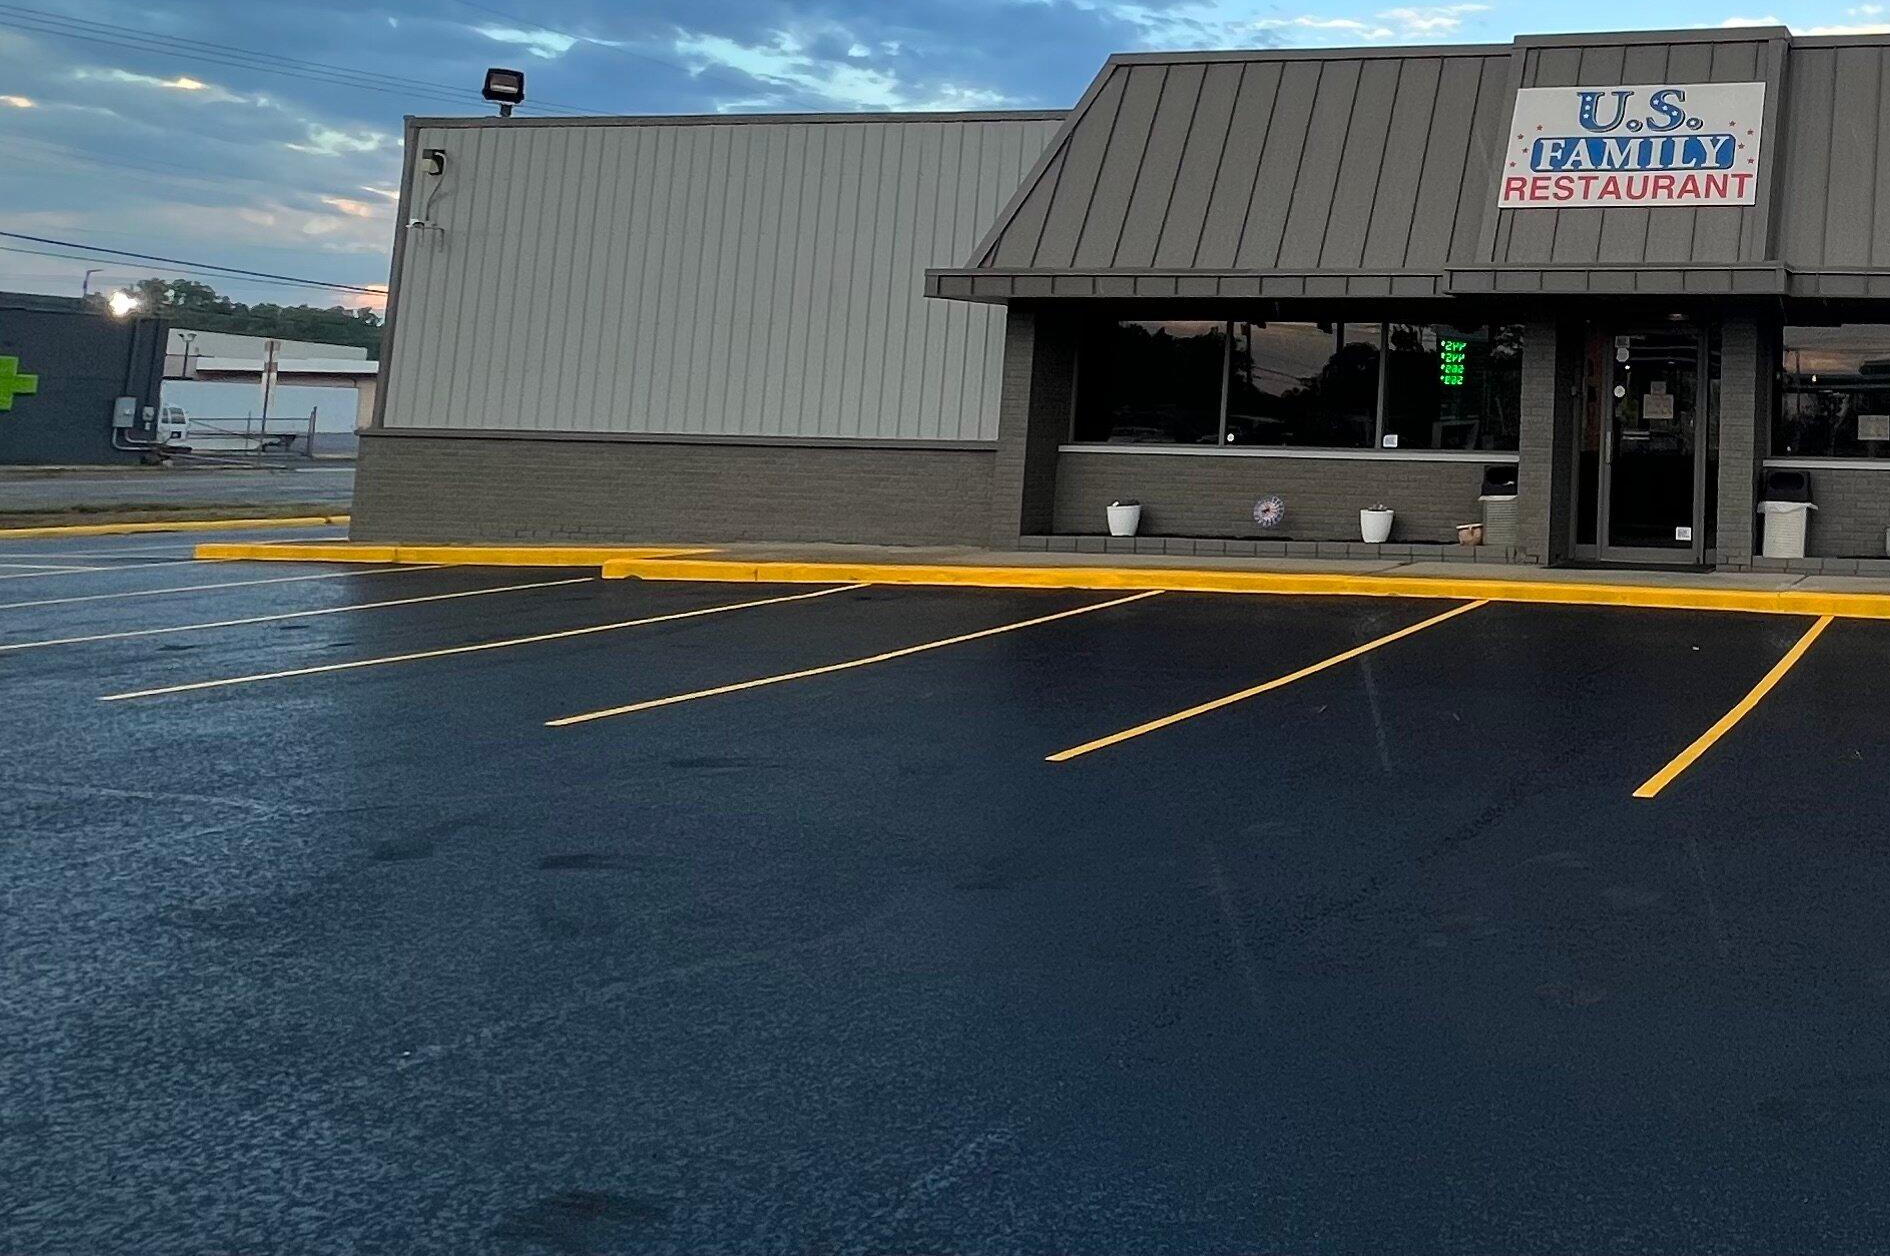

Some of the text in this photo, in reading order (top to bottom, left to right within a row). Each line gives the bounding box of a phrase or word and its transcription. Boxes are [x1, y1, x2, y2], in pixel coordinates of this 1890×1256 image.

[1577, 89, 1703, 132] U.S.
[1534, 135, 1730, 171] FAMILY
[1503, 173, 1754, 201] RESTAURANT
